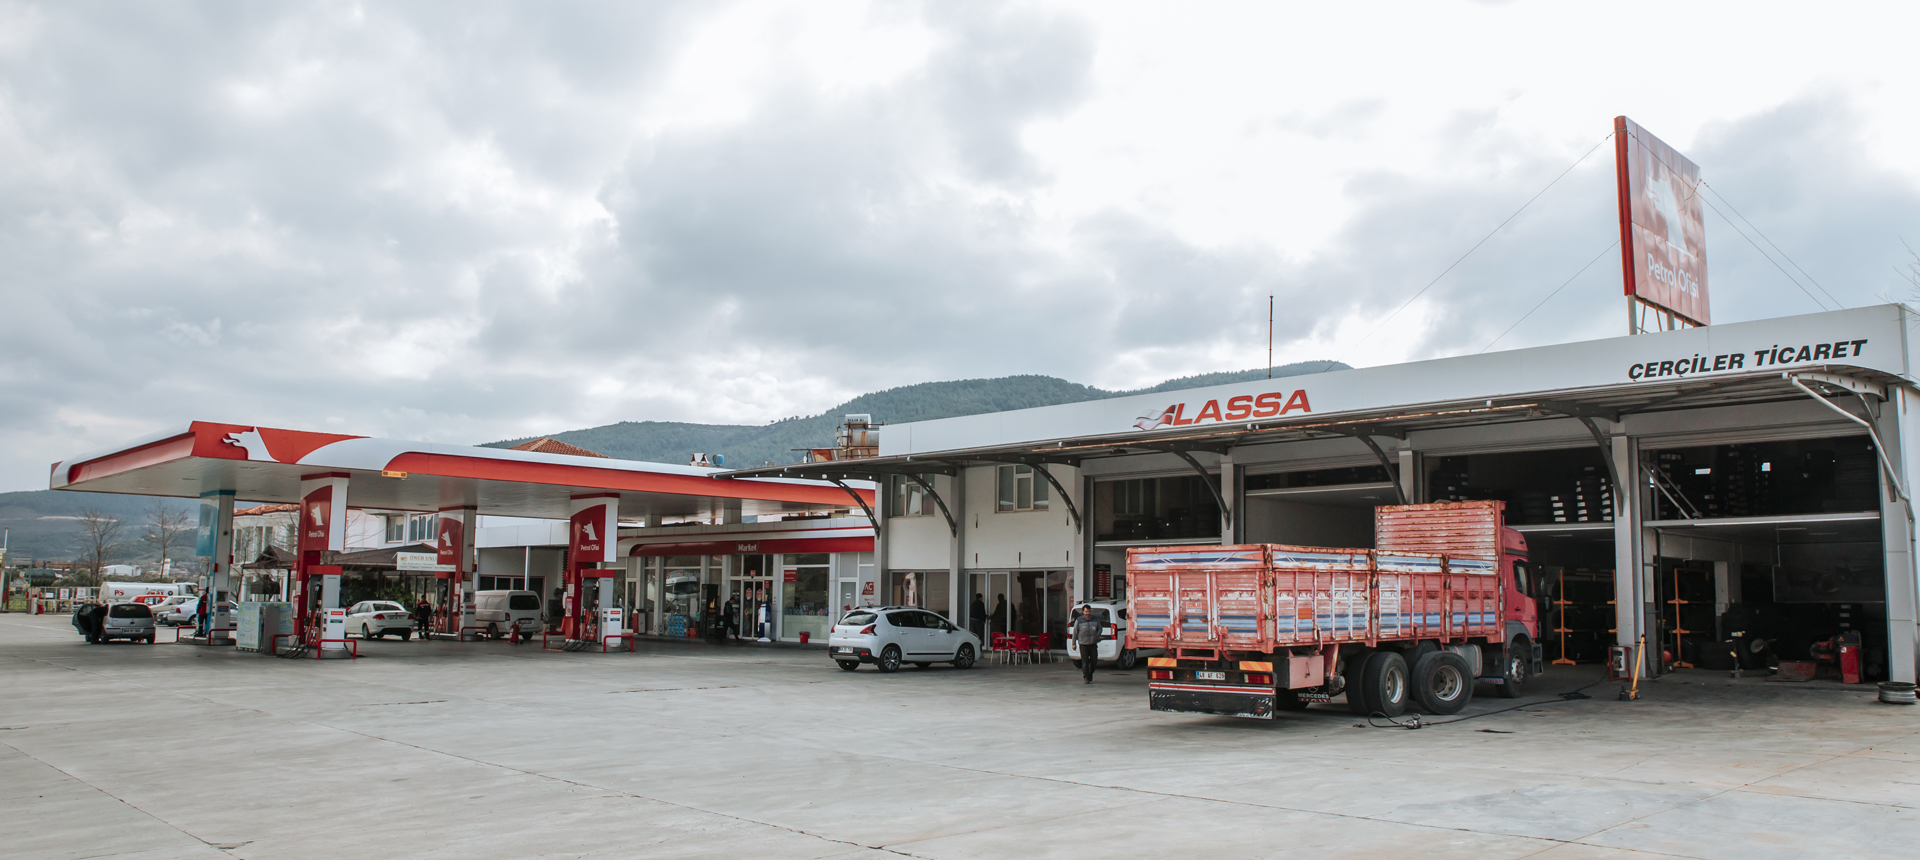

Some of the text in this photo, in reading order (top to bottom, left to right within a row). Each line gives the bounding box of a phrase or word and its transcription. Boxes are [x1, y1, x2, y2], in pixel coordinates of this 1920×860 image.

[1647, 252, 1677, 288] Petrol
[1628, 338, 1868, 381] ÇERÇİLER TİCARET
[1173, 389, 1312, 426] LASSA
[308, 530, 317, 538] Petrol
[738, 543, 757, 552] Market
